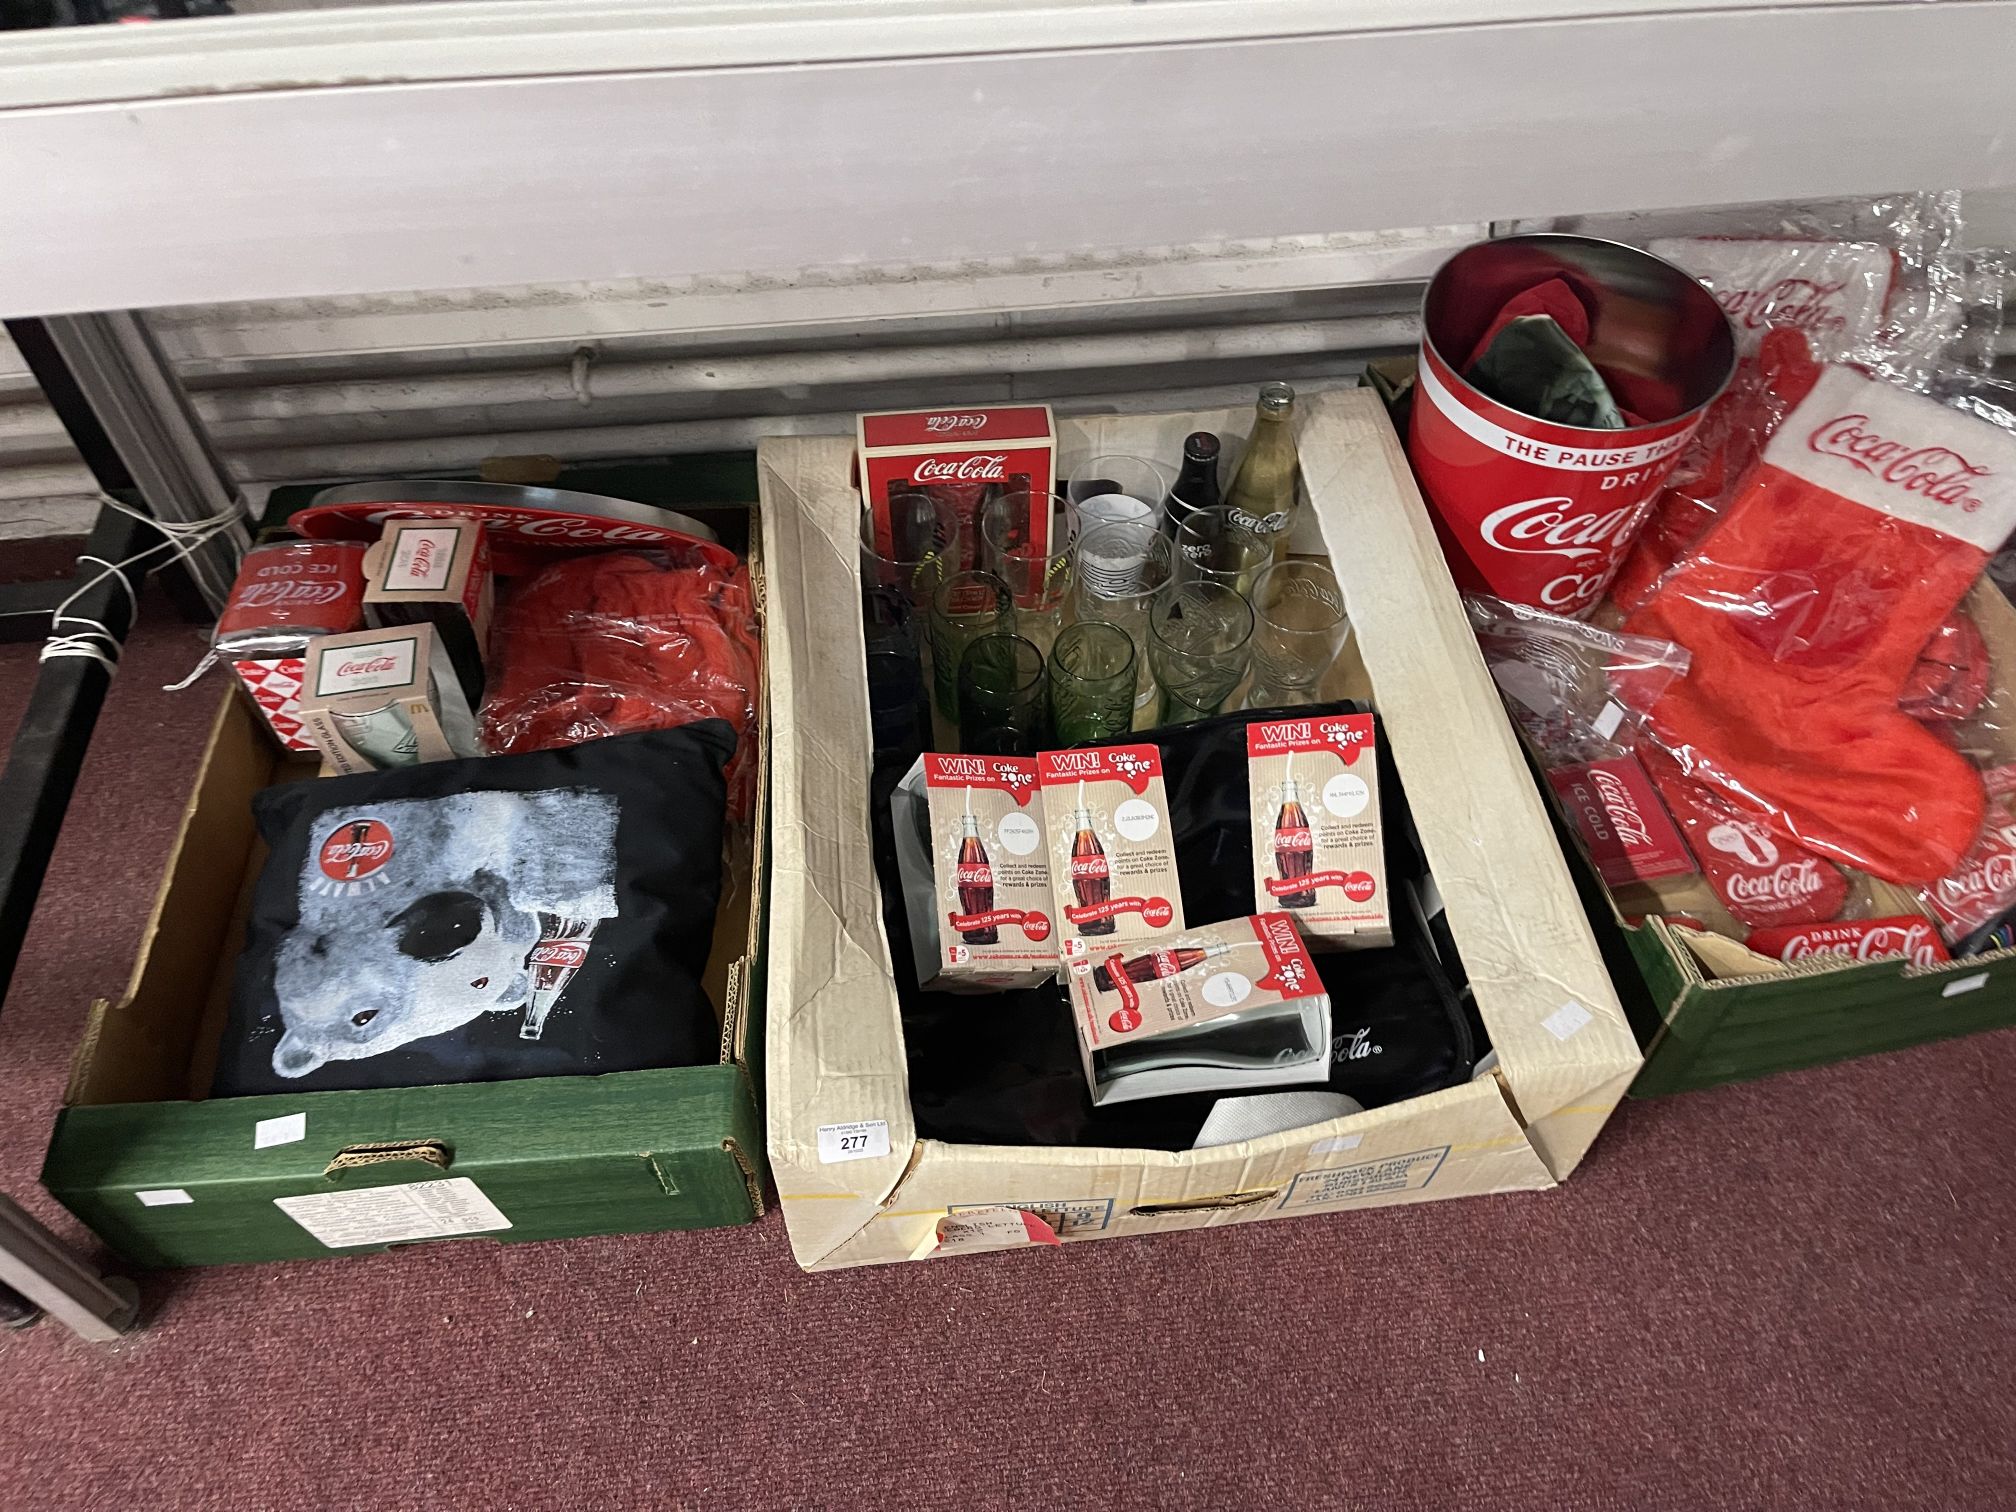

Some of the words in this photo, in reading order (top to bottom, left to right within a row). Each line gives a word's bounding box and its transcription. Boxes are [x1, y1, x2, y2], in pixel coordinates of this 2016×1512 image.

[924, 413, 987, 431] Coca-Cola
[1504, 435, 1549, 461] THE
[1557, 450, 1636, 468] PAUSE
[914, 455, 1008, 482] Coca-Cola
[410, 539, 436, 577] Coca-Cola
[257, 564, 303, 577] COLD
[308, 563, 338, 574] ICE
[234, 580, 347, 610] Coca-Cola
[337, 656, 398, 677] Coca-Cola
[1255, 742, 1287, 750] Fantastic
[1327, 731, 1363, 744] zone
[1261, 722, 1312, 742] WIN!
[1320, 722, 1349, 733] Coke
[938, 758, 986, 775] WIN!
[992, 762, 1019, 773] Coke
[1046, 771, 1078, 779] Fantastic
[1116, 760, 1151, 773] zone
[1051, 752, 1100, 771] WIN!
[1108, 752, 1137, 763] Coke
[966, 774, 985, 782] Prizes
[1000, 772, 1033, 785] zone
[1571, 782, 1590, 803] ICE
[1584, 806, 1609, 841] COLD
[1587, 769, 1653, 847] Coca-Cola
[1274, 832, 1312, 848] Coca-Cola
[1354, 841, 1373, 849] prizes
[323, 840, 390, 863] Coca-Cola
[957, 867, 992, 882] Coca-Cola
[1071, 859, 1108, 876] Coca-Cola
[1130, 862, 1144, 870] great
[1271, 884, 1298, 892] Celebrate
[1298, 879, 1310, 887] 125
[1311, 875, 1330, 884] years
[1344, 881, 1373, 892] Coca-Cola
[1726, 857, 1824, 904] Coca-Cola
[1071, 910, 1098, 919] Celebrate
[1098, 906, 1110, 914] 125
[1110, 902, 1129, 912] years
[1143, 906, 1170, 918] Coca-Cola
[955, 919, 981, 927] Celebrate
[981, 915, 992, 923] 125
[992, 913, 1010, 922] years
[1023, 921, 1048, 931] Coca-Cola
[1810, 927, 1862, 942] DRINK
[1268, 919, 1300, 955] WIN!
[1290, 958, 1307, 980] Coke
[841, 1135, 868, 1150] 277
